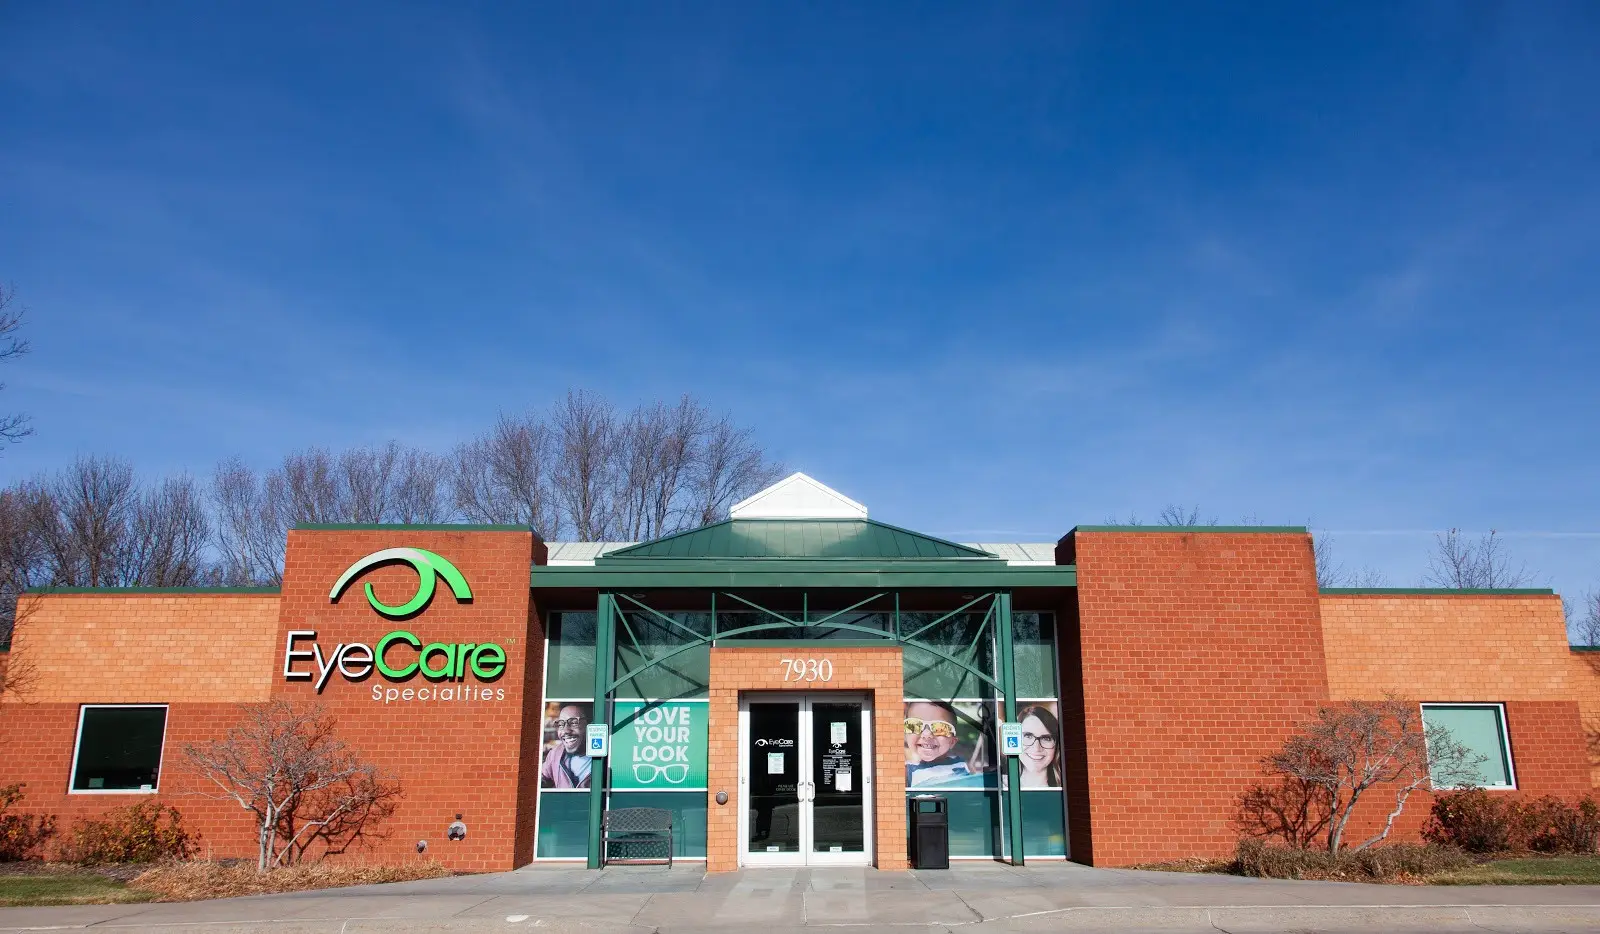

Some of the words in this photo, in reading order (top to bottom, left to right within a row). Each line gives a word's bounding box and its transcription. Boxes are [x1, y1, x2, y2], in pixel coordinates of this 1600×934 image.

[284, 631, 506, 690] EyeCare
[779, 658, 833, 682] 7930
[372, 684, 505, 704] Specialties
[634, 706, 691, 726] LOVE
[634, 727, 690, 743] YOUR
[632, 745, 689, 762] LOOK
